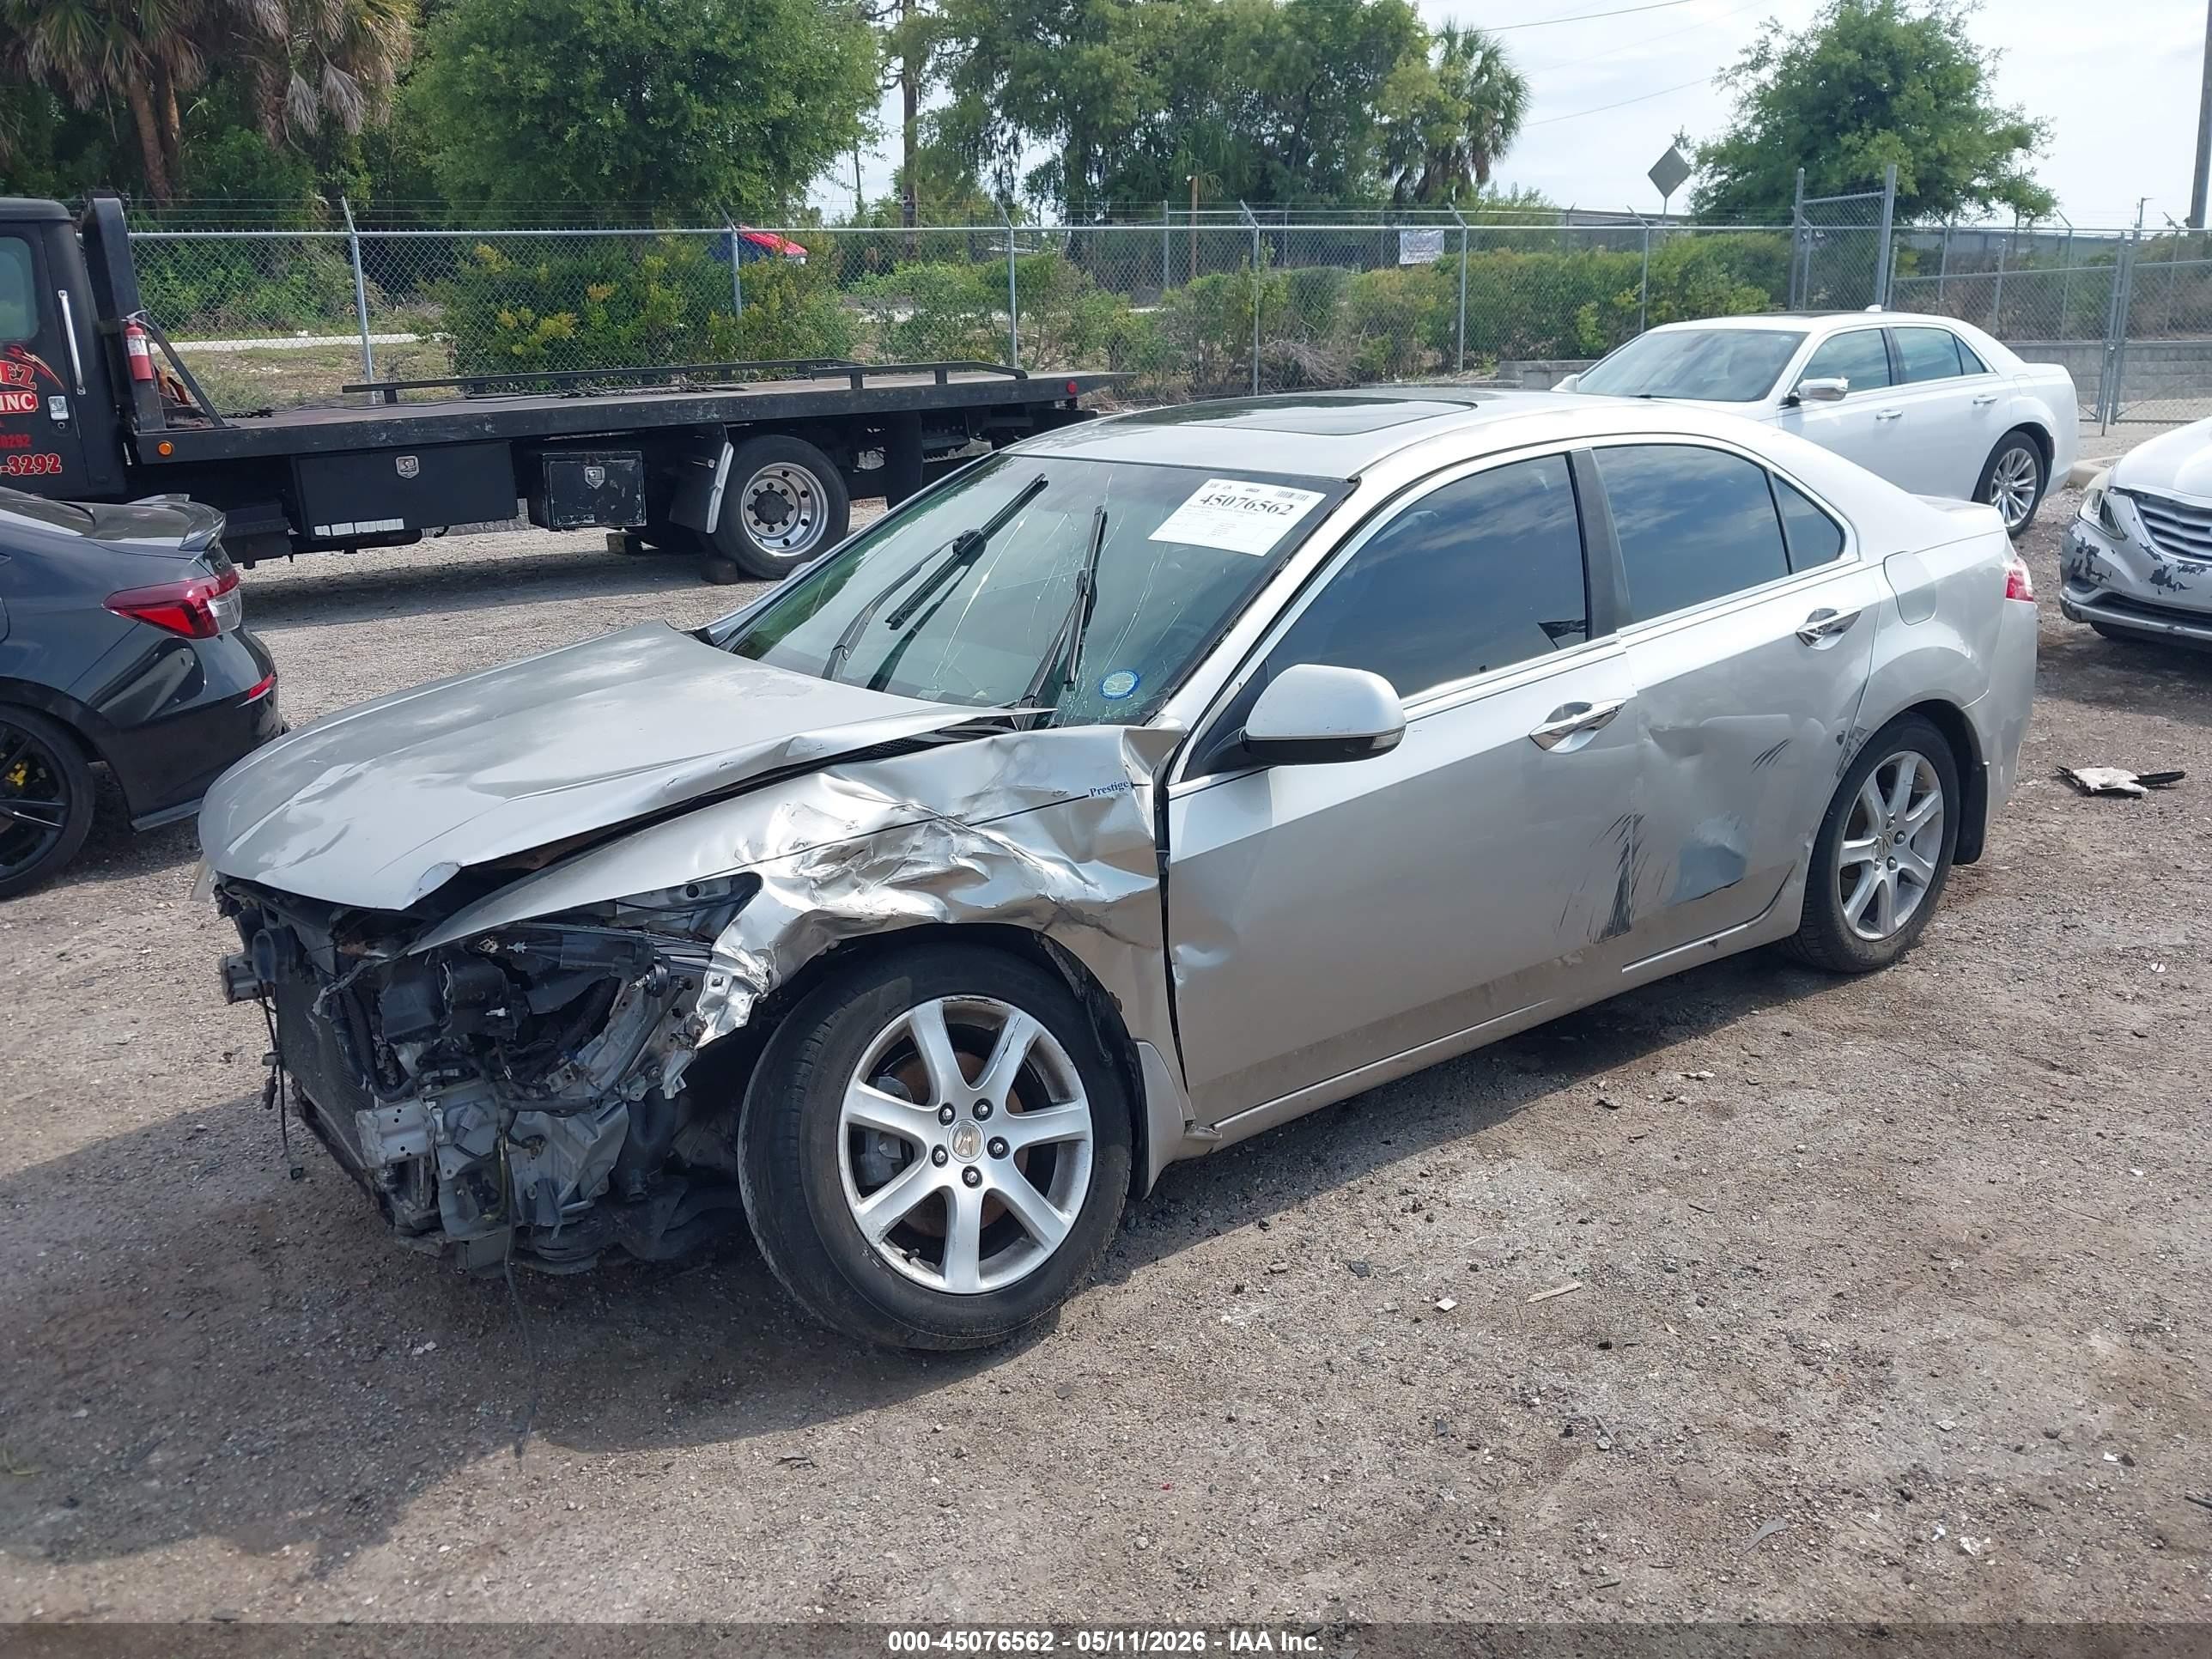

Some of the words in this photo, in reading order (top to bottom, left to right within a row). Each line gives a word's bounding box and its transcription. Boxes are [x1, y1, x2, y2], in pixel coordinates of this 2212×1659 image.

[0, 393, 33, 410] INC
[1200, 494, 1294, 515] 45076562
[1090, 781, 1129, 797] Prestige
